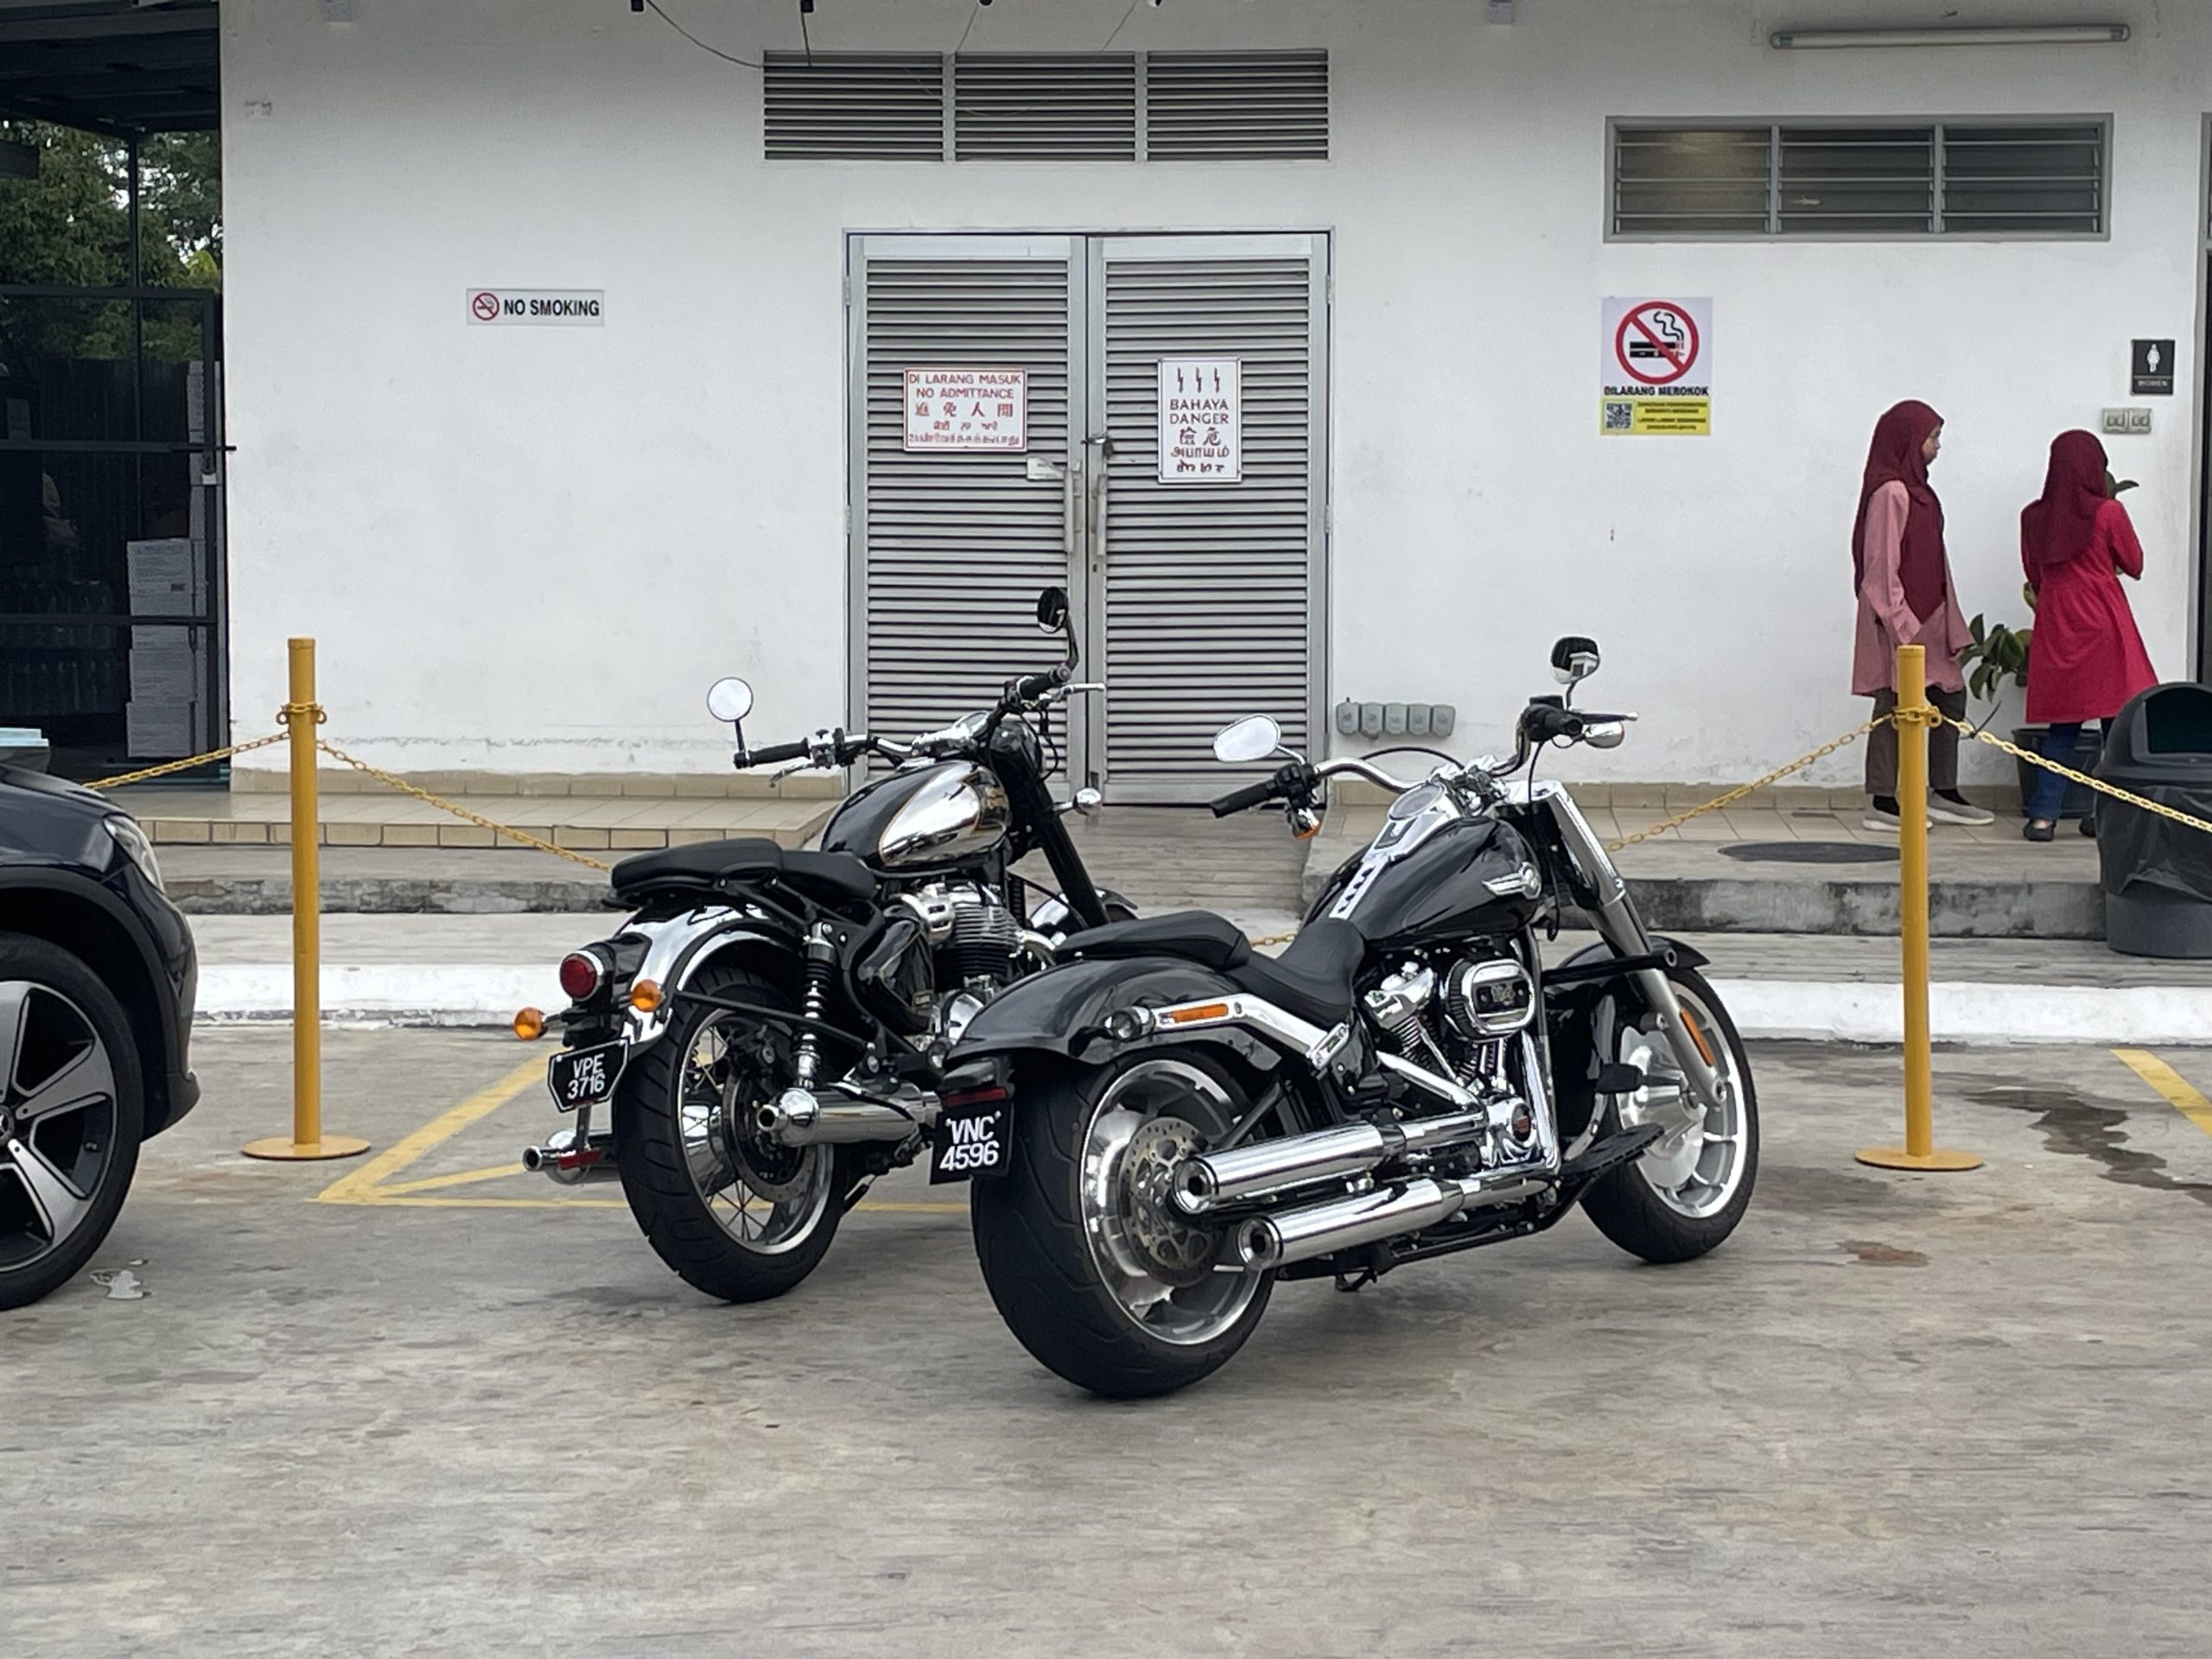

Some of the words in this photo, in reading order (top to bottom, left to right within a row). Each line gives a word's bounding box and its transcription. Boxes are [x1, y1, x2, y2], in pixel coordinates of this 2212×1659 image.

[504, 299, 525, 315] NO
[530, 299, 600, 316] SMOKING
[909, 374, 919, 384] DI
[925, 374, 974, 384] LARANG
[979, 374, 1020, 384] MASUK
[916, 388, 934, 398] NO
[939, 388, 1014, 398] ADMITTANCE
[1604, 386, 1656, 396] DILARANG
[1658, 386, 1709, 396] MEROKOK
[1169, 399, 1229, 410] BAHAYA
[1169, 413, 1230, 424] DANGER
[573, 1053, 605, 1079] VPE
[567, 1072, 606, 1099] 3716
[950, 1116, 995, 1144] VNC
[939, 1140, 1000, 1172] 4596
